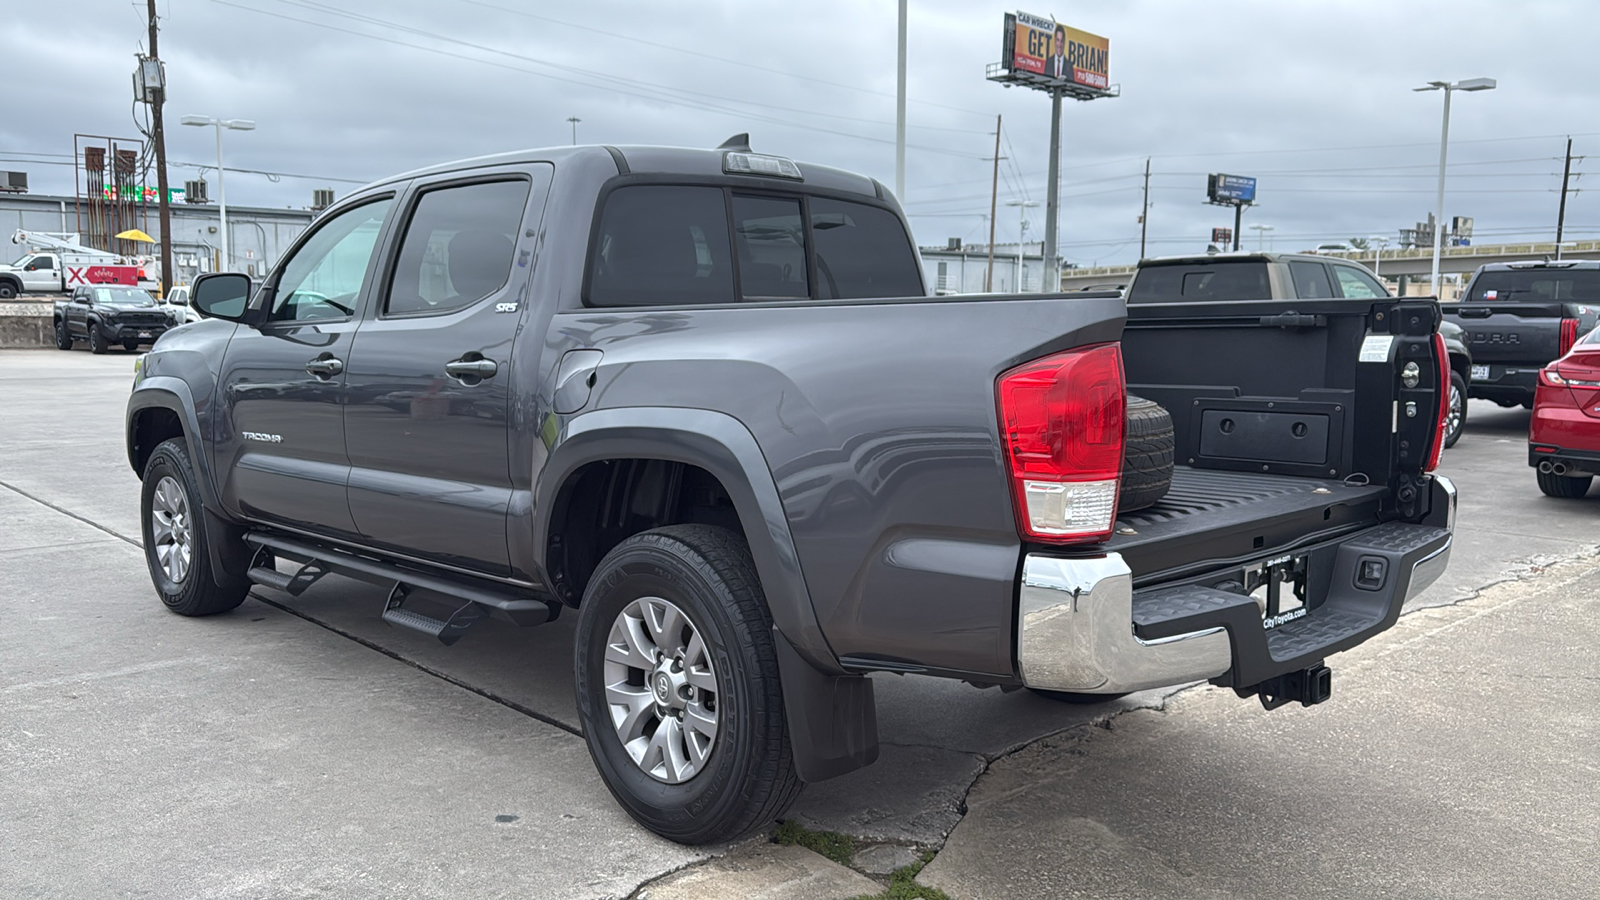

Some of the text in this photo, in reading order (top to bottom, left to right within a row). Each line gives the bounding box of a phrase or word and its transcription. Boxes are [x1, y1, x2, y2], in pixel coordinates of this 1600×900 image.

[1018, 13, 1054, 31] CAR WRECK?
[1028, 29, 1052, 60] GET
[1068, 40, 1107, 74] BRIAN!
[495, 302, 518, 312] SR5
[1468, 333, 1520, 344] DRA
[242, 431, 283, 443] TACOMA
[1263, 608, 1306, 629] CityToyota.com
